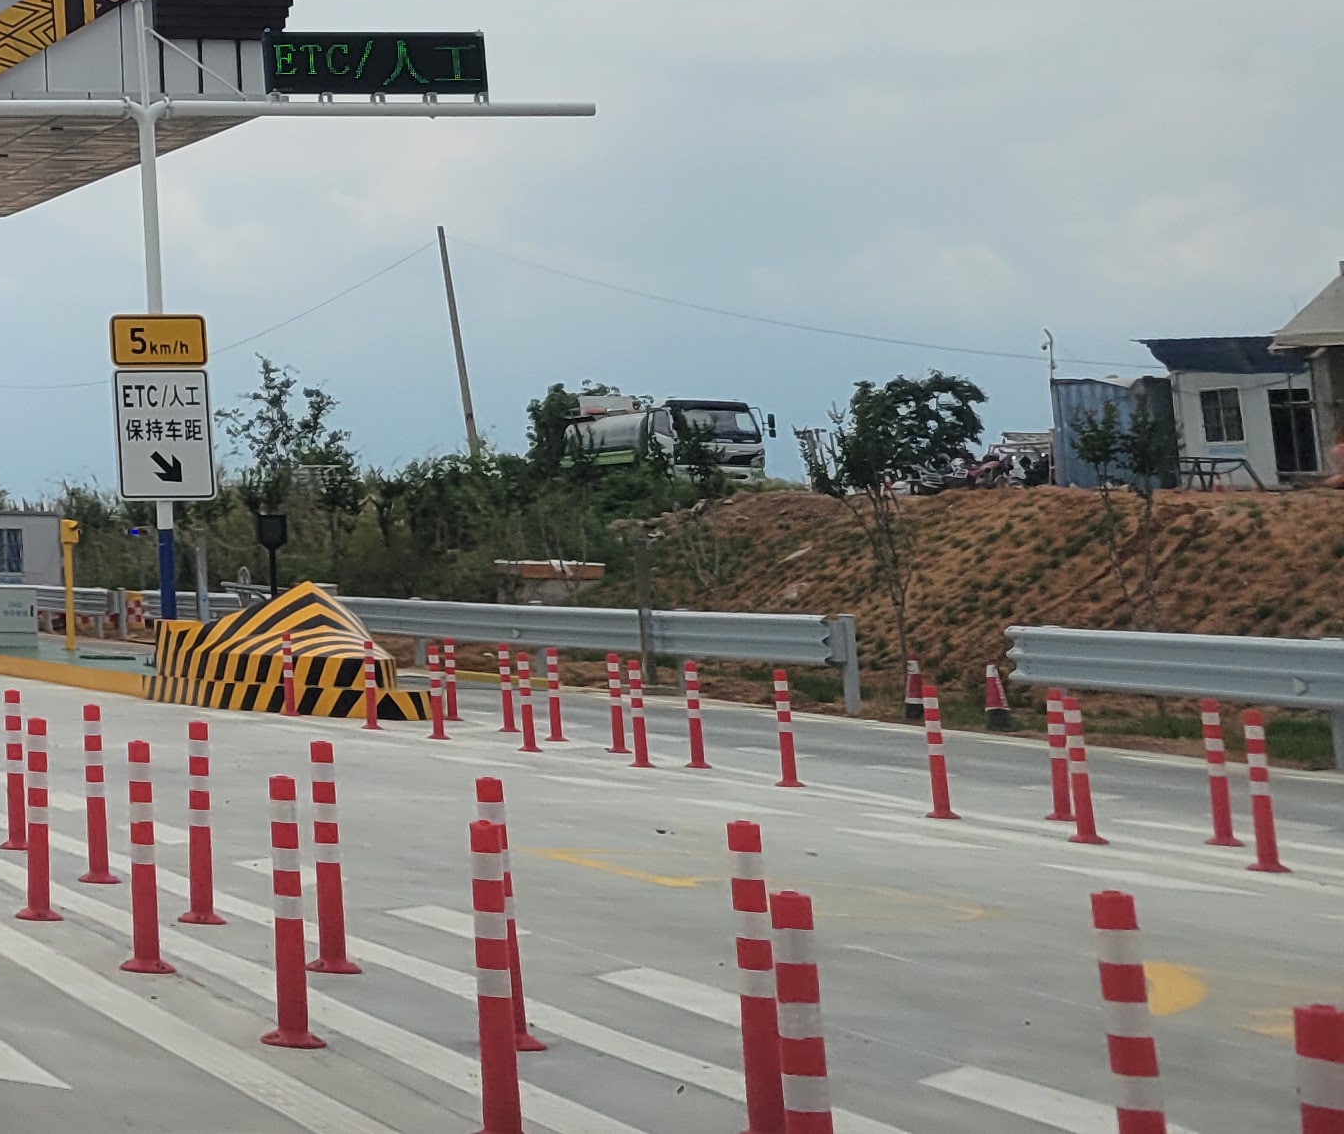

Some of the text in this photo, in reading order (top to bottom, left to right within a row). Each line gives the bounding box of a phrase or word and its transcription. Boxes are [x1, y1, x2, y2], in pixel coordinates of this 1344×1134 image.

[273, 40, 482, 86] ETC/人工
[130, 327, 189, 355] 5km/h
[122, 384, 201, 408] ETC/人工
[125, 418, 204, 442] 保持车距
